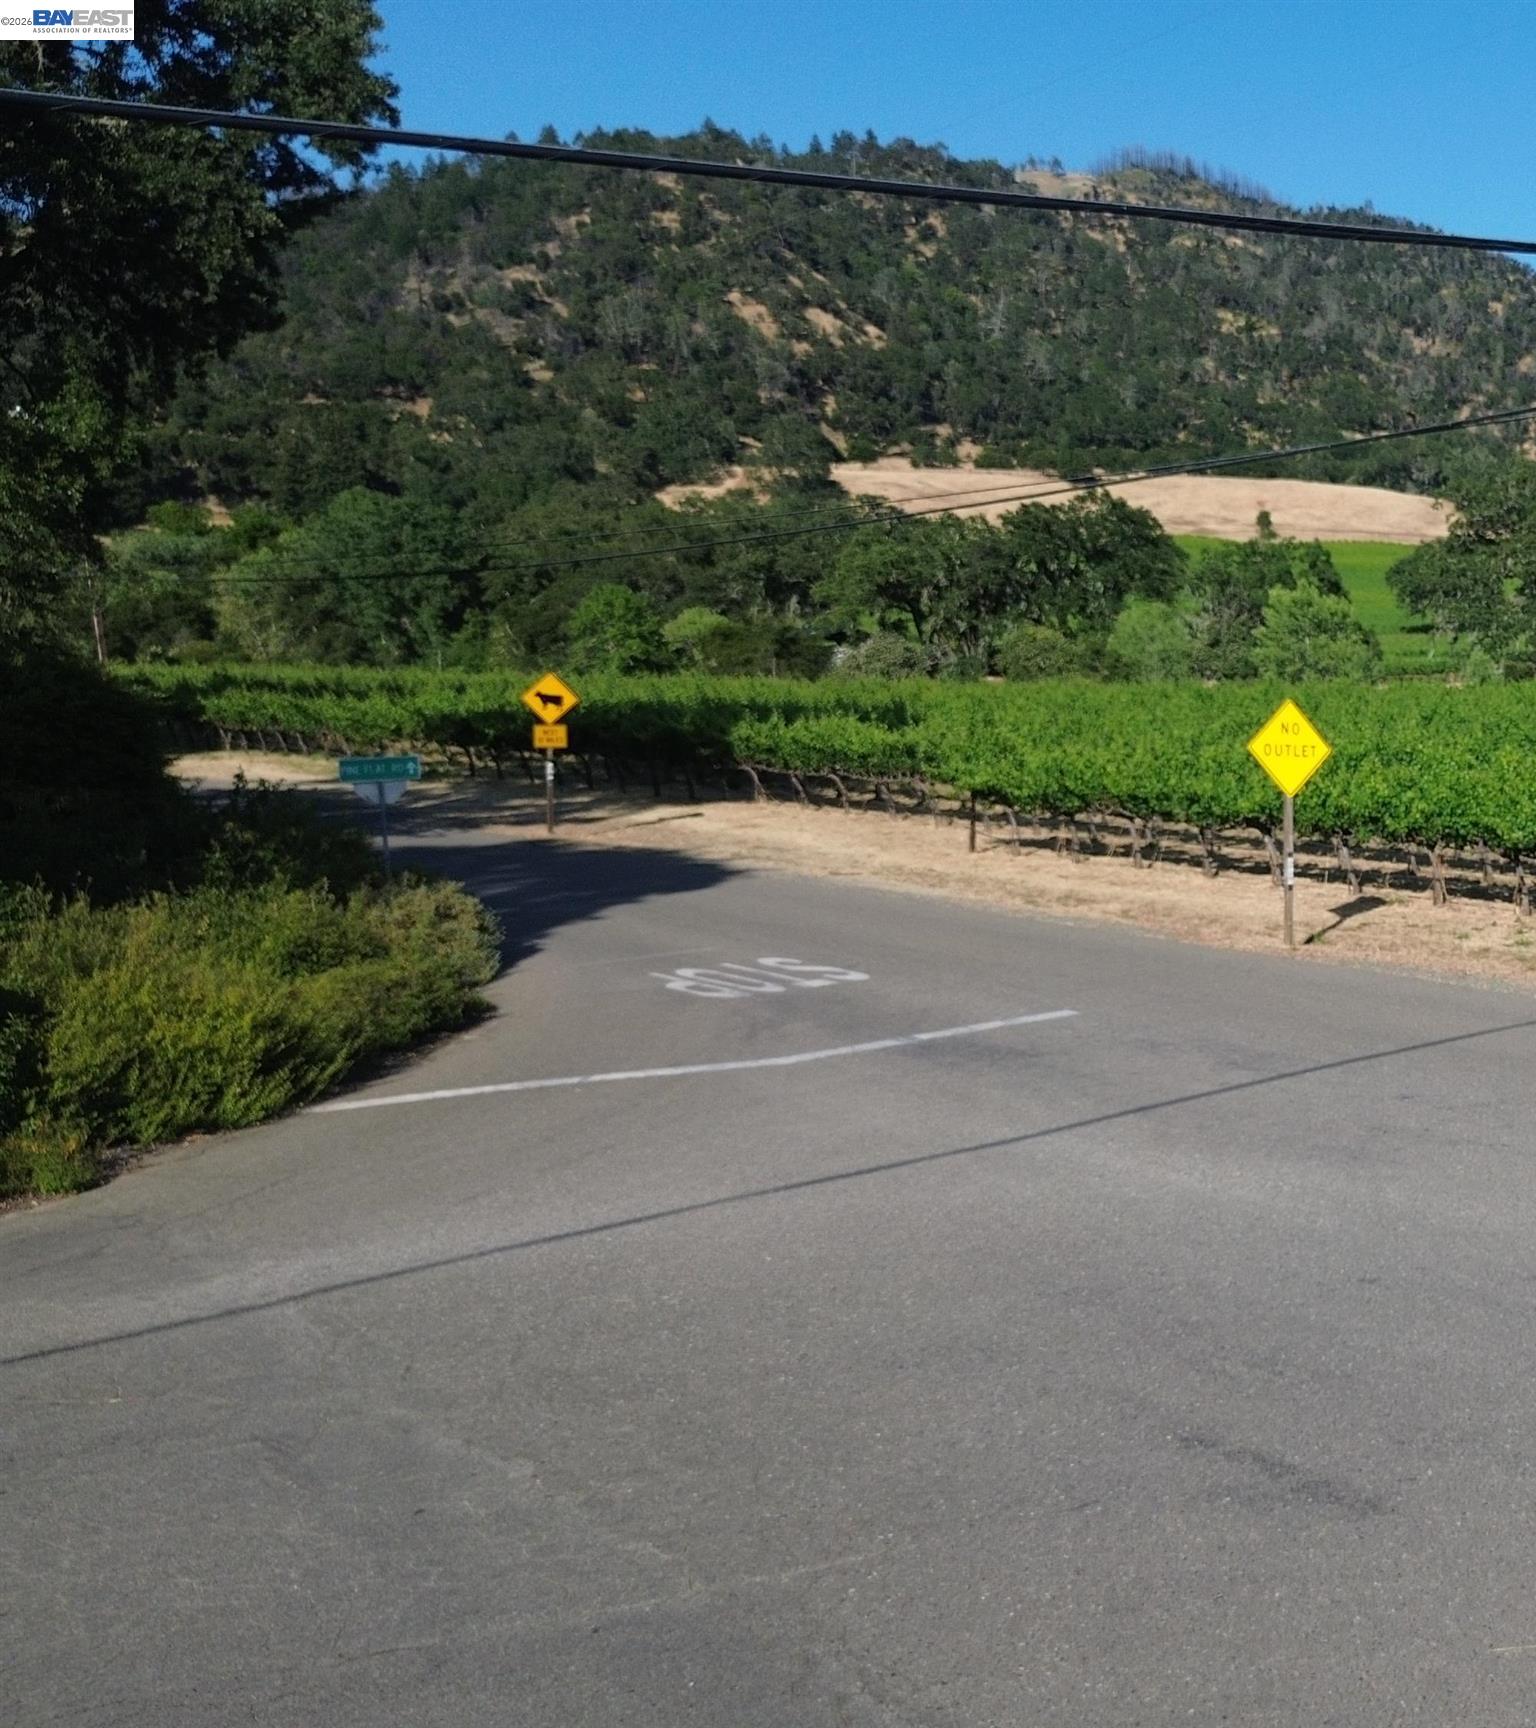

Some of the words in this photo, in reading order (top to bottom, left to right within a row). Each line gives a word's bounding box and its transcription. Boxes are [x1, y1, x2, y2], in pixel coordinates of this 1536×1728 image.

[1281, 722, 1300, 735] NO
[1264, 743, 1317, 758] OUTLET
[649, 956, 871, 999] STOP
